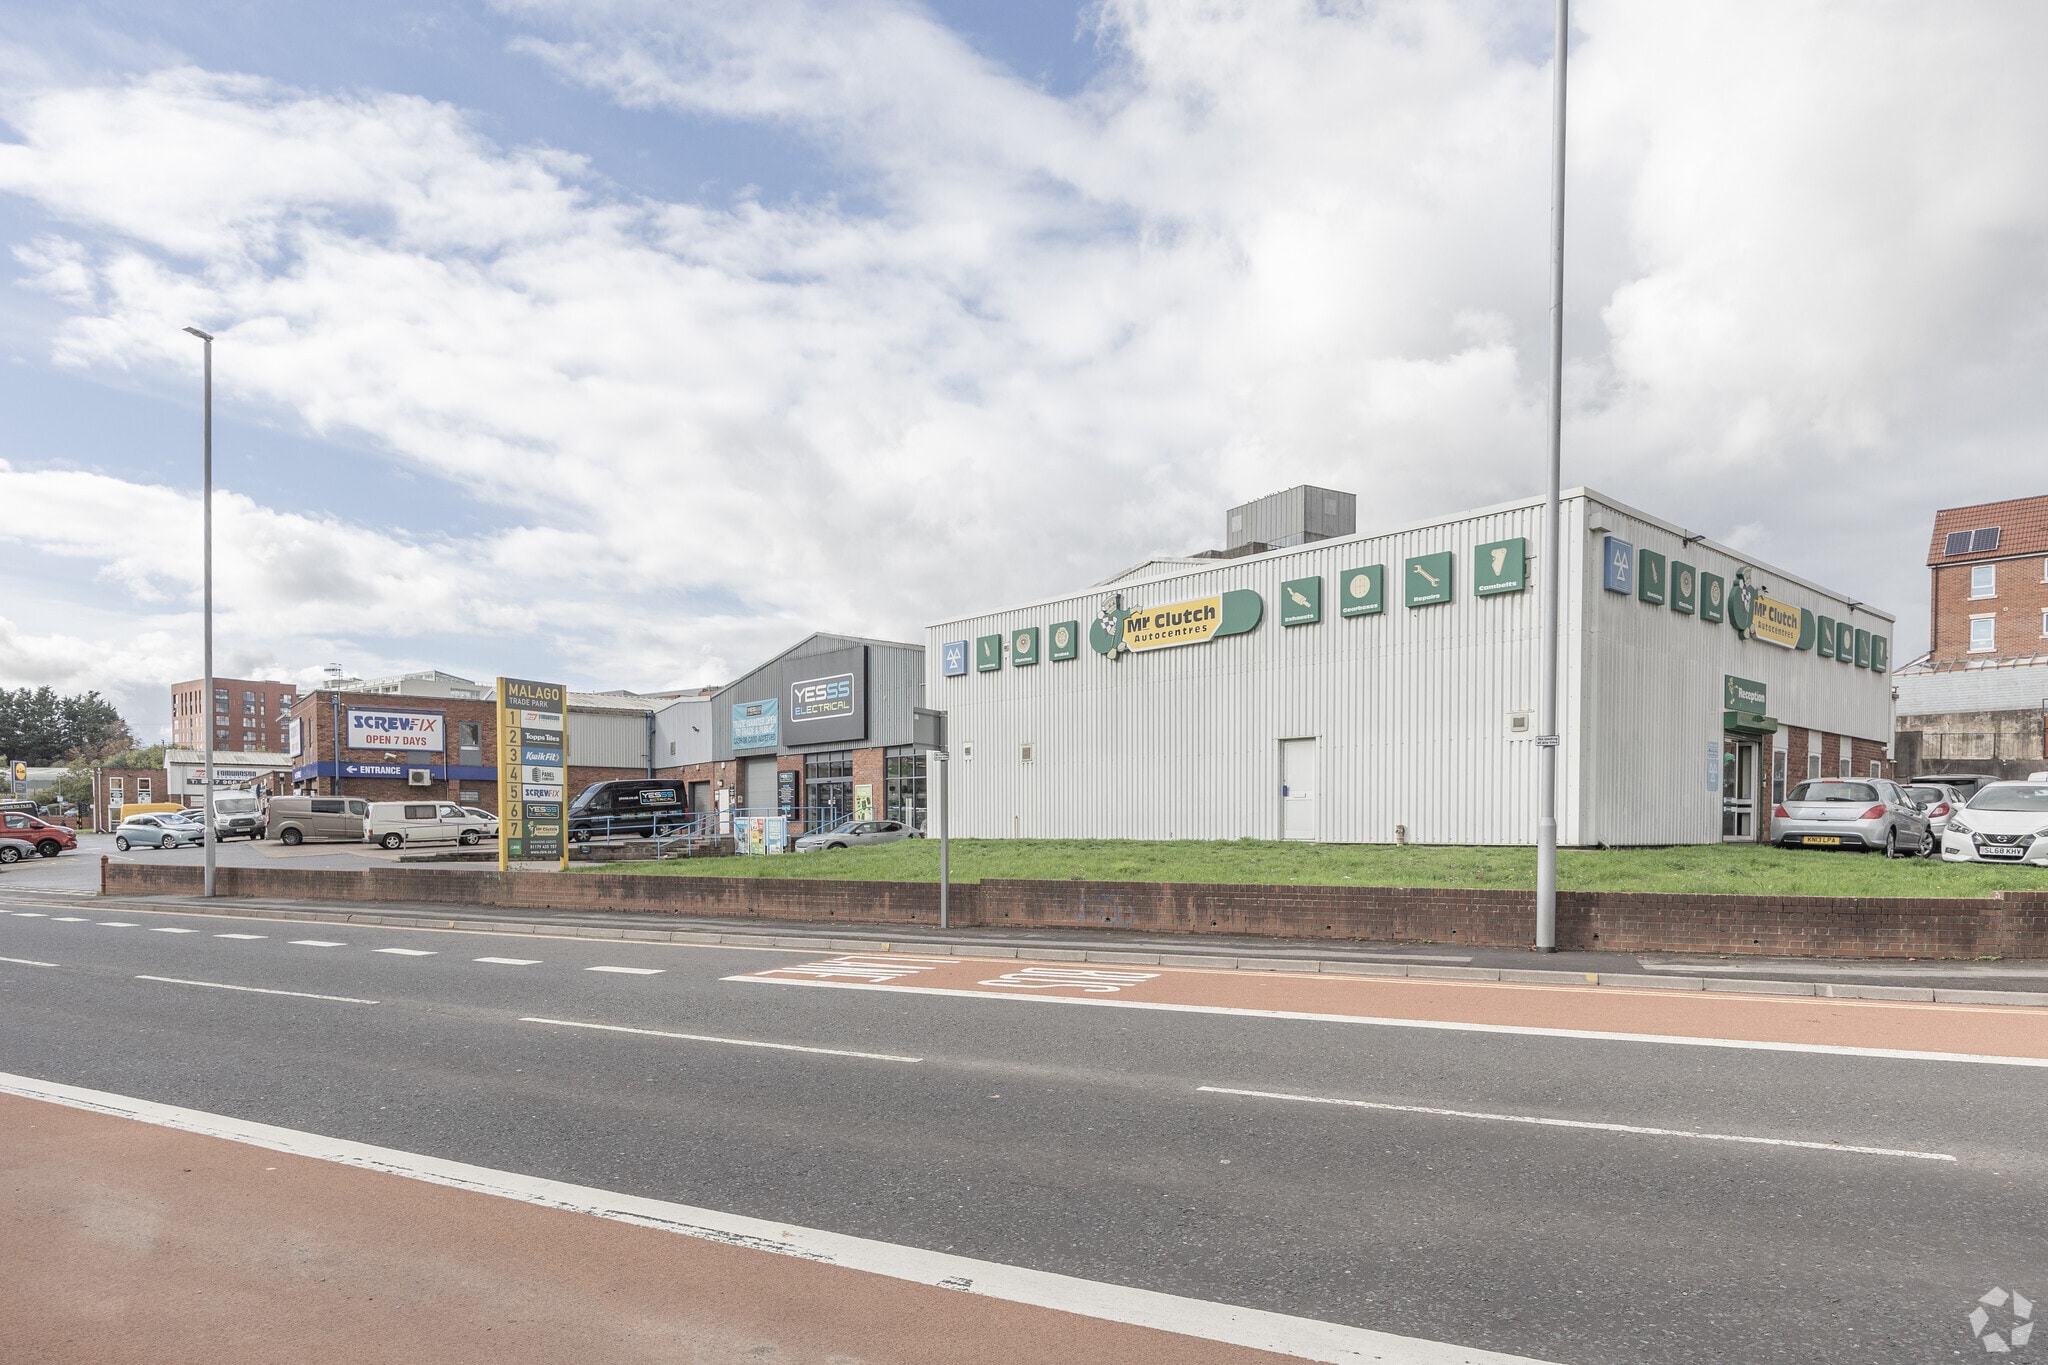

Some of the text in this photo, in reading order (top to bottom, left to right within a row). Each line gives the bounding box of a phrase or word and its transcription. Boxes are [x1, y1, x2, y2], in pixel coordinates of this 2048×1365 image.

[1479, 581, 1517, 591] Cambelts
[1413, 593, 1440, 602] Repairs
[1342, 603, 1378, 613] Gearboxes
[1754, 601, 1797, 629] Mr Clutch
[1128, 605, 1215, 633] Mr Clutch
[1284, 614, 1314, 622] Exhausts
[1134, 625, 1207, 643] Autocentres
[1758, 620, 1794, 639] Autocentres
[509, 683, 560, 701] MALAGO
[794, 680, 850, 703] YESSS
[1738, 688, 1765, 704] Reception
[509, 697, 548, 708] TRADE PARK
[794, 701, 850, 715] ELECTRICAL
[354, 715, 438, 733] SCREWFIX
[510, 711, 515, 725] 1
[366, 735, 427, 746] OPEN 7 DAYS
[510, 730, 560, 744] 2 Topps Tiles
[510, 748, 517, 762] 3
[360, 766, 401, 775] ENTRANCE
[510, 767, 517, 780] 4
[511, 785, 560, 799] 5 SCREWFIX
[642, 791, 674, 799] YESSS
[511, 804, 518, 817] 6
[511, 823, 518, 836] 7
[1984, 847, 2005, 855] SL68
[754, 955, 962, 983] LANE
[978, 967, 1162, 993] BUS
